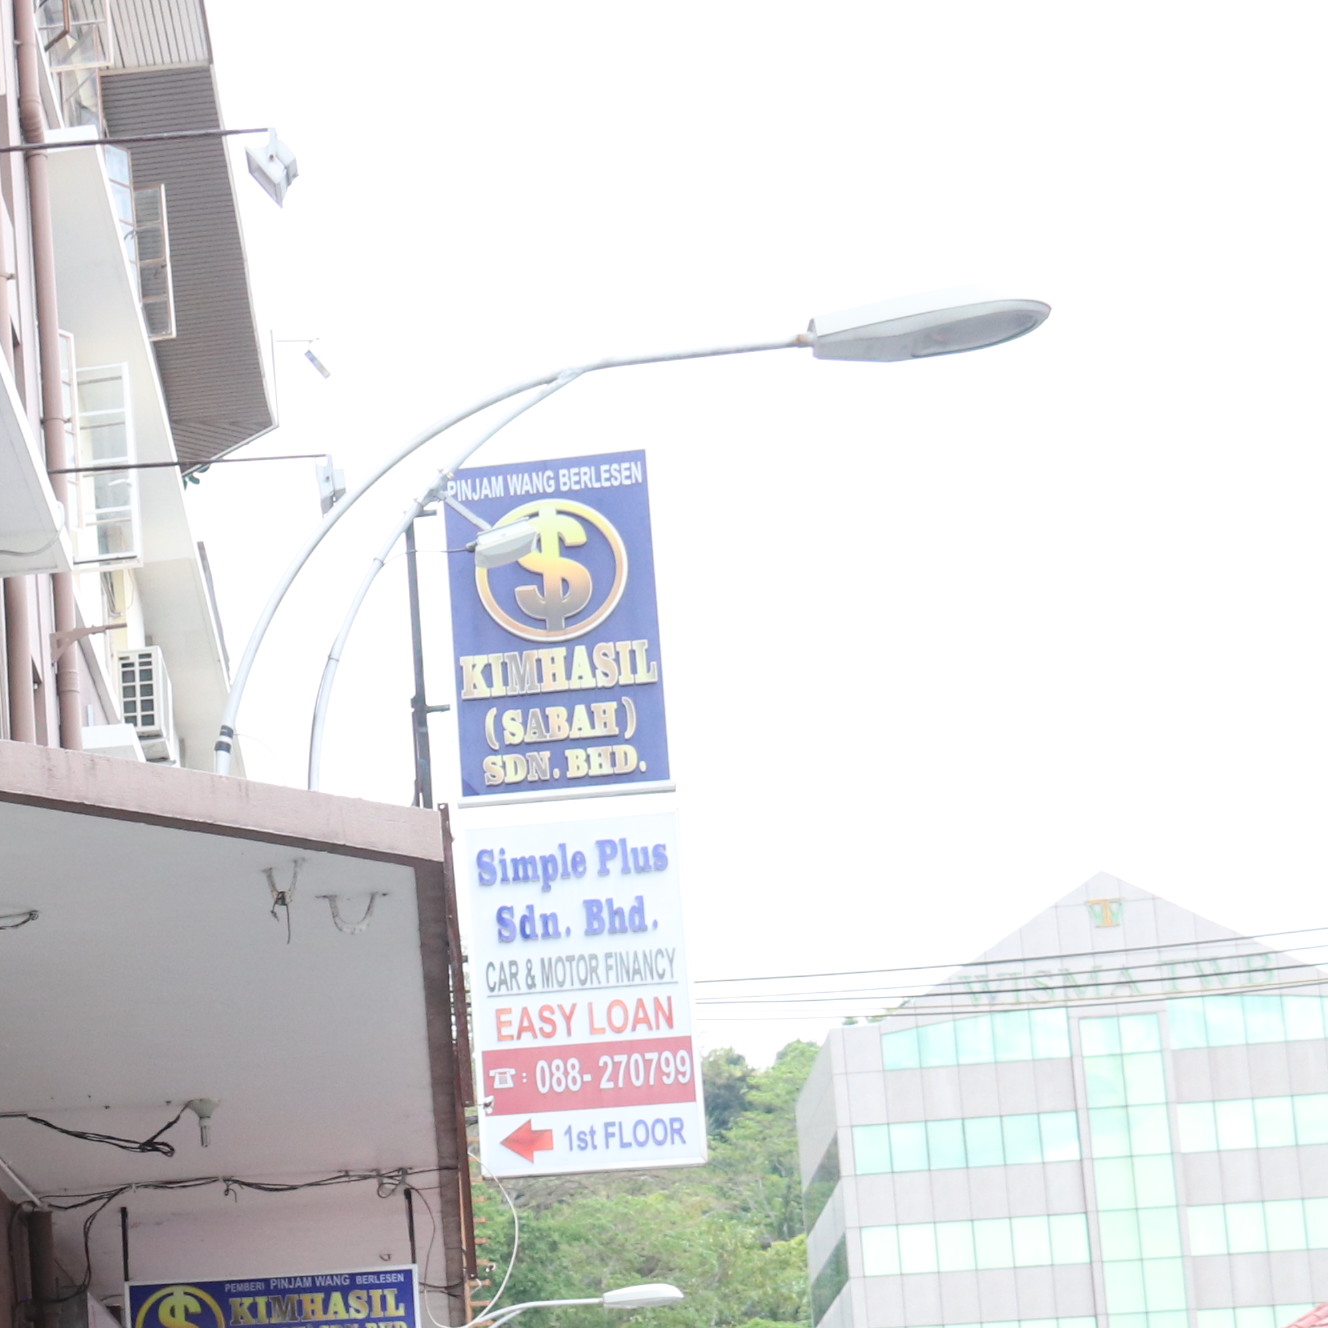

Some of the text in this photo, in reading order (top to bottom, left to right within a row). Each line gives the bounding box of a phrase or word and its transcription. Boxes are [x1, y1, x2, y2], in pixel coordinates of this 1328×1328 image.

[447, 461, 643, 502] PINJAM WANG BERLESEN
[459, 639, 659, 701] KIMHASIL
[476, 837, 669, 892] Simple Plus
[496, 895, 659, 943] Sdn. Bhd.
[486, 947, 676, 993] CAR & MOTOR FINANCY
[495, 995, 674, 1042] EASY LOAN
[598, 1049, 692, 1090] 270799
[564, 1116, 687, 1153] 1st FLOOR
[224, 1272, 404, 1293] PEMBERI PINJAM WANG BERLESEN
[229, 1288, 406, 1326] KIMHASIL
